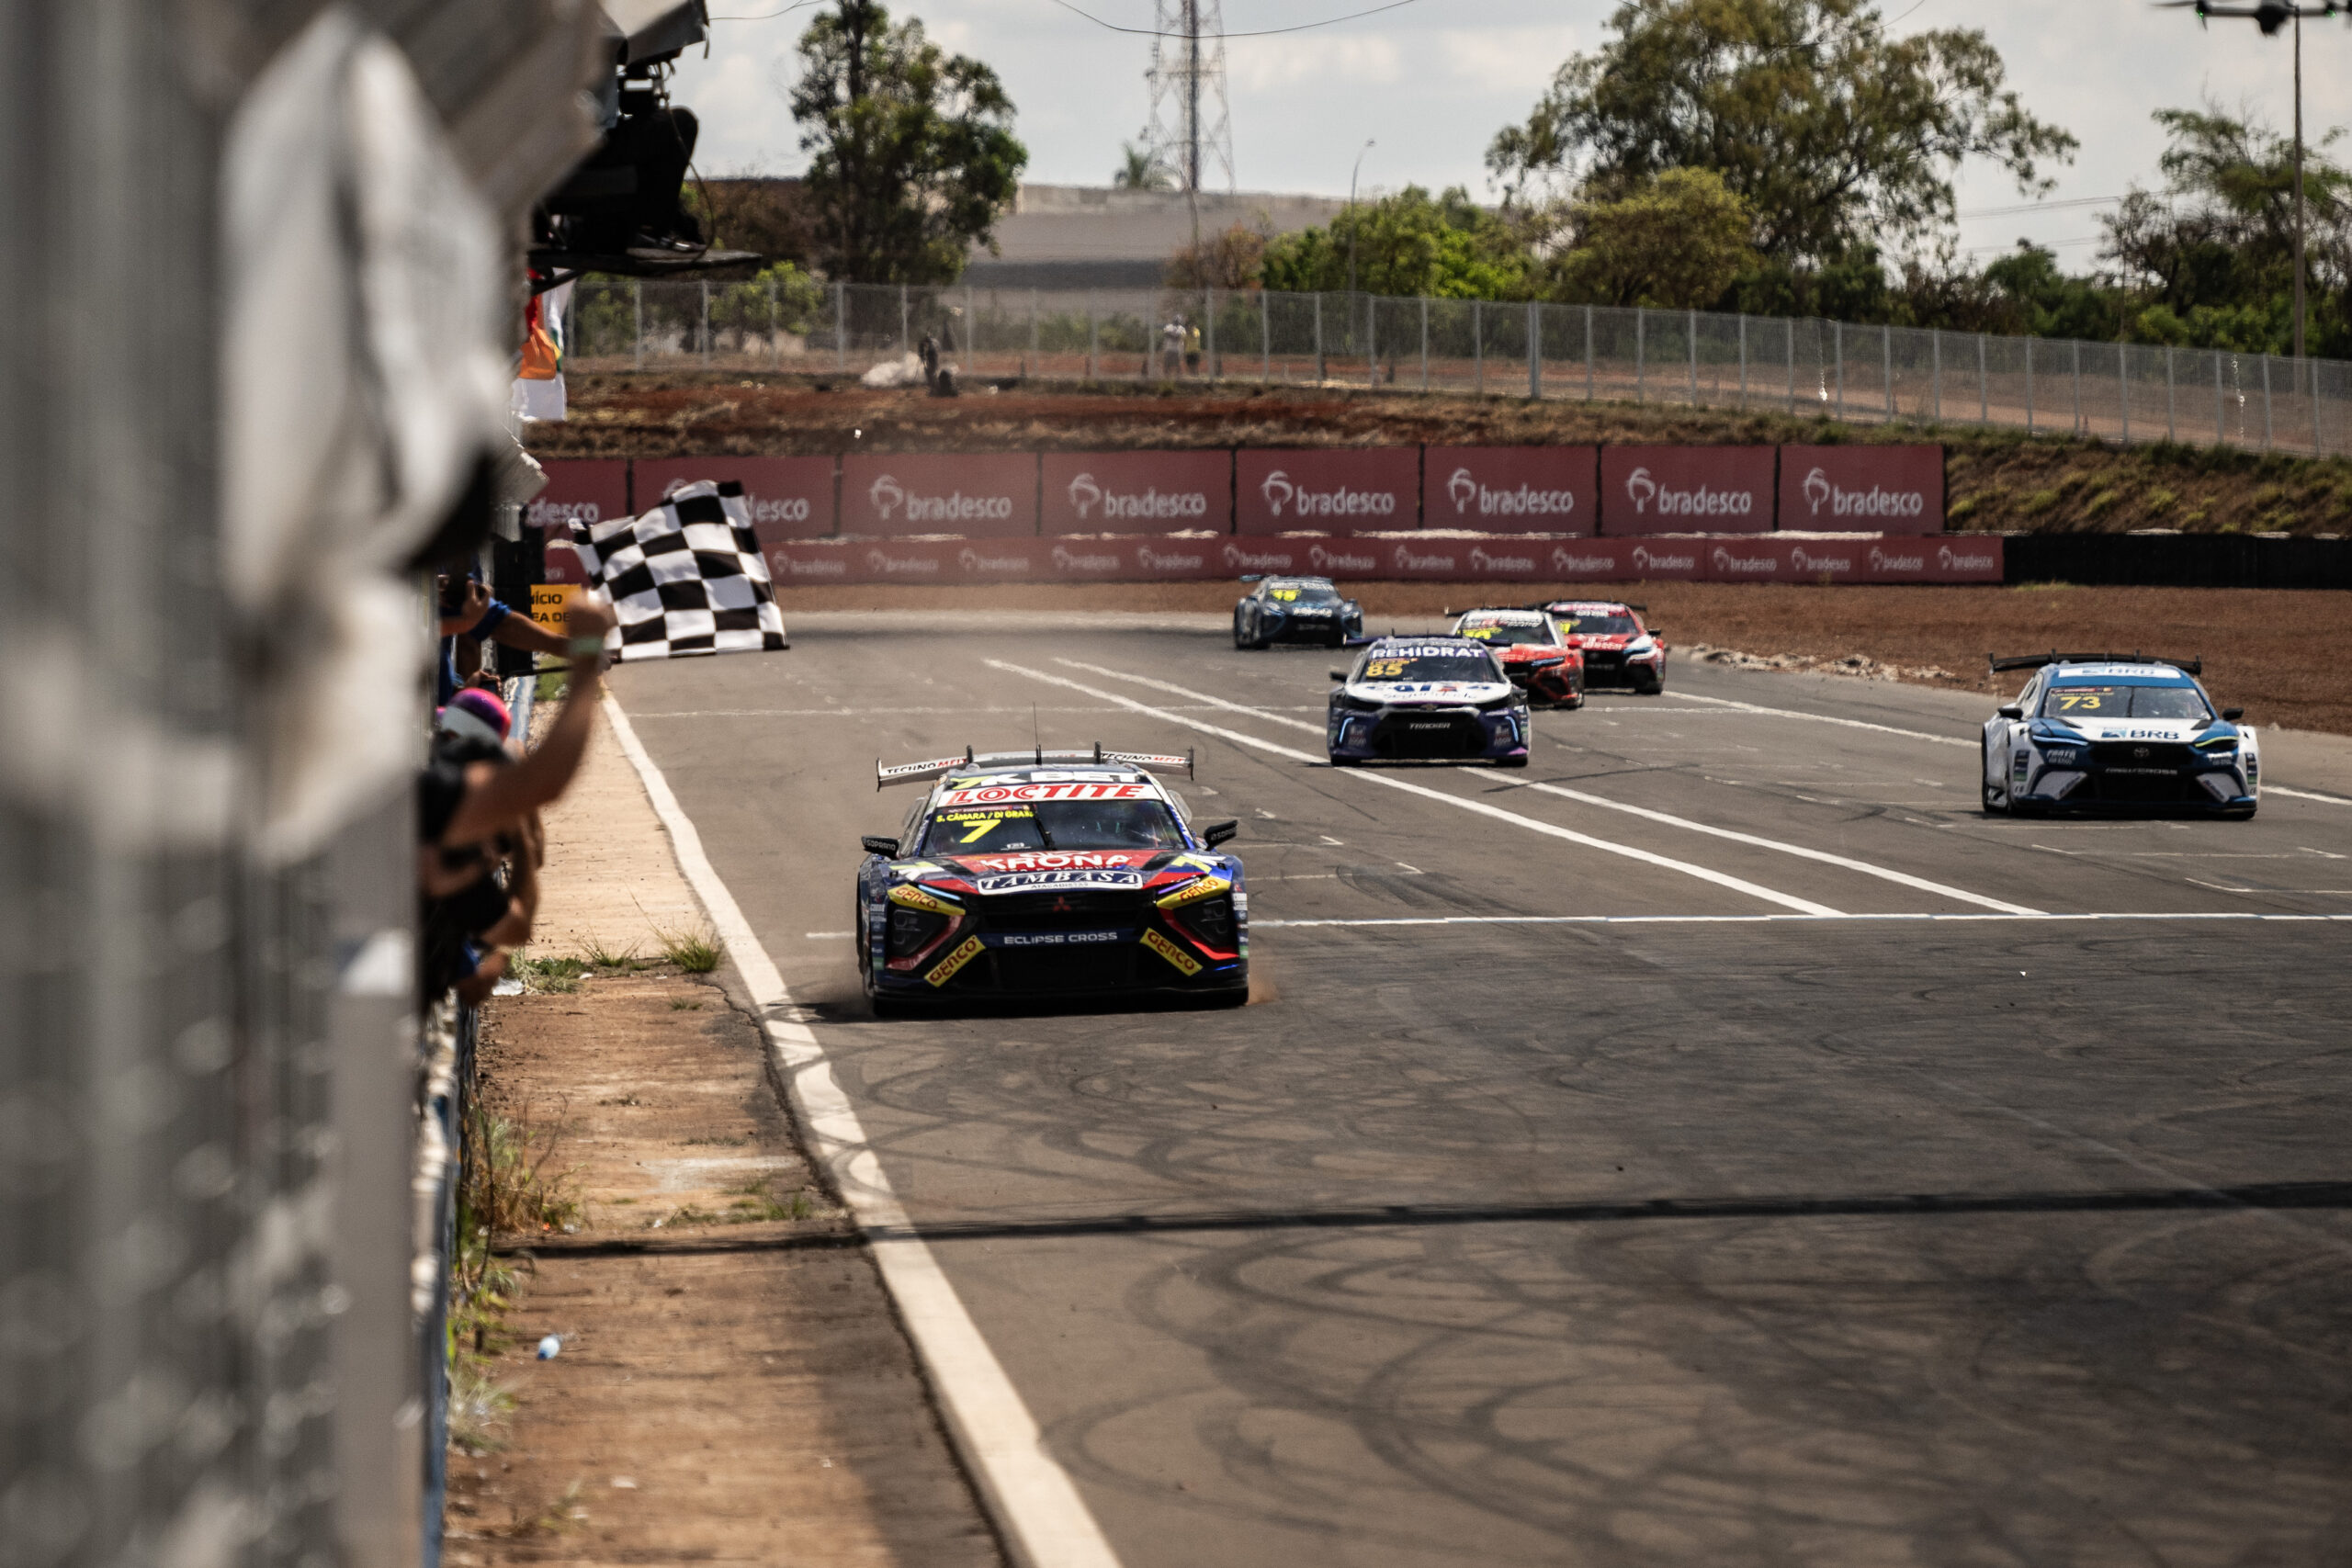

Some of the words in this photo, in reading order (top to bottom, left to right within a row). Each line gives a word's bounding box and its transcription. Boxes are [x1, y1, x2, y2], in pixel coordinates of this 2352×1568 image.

[905, 490, 1011, 522] bradesco
[1105, 489, 1206, 518] bradesco
[1296, 485, 1395, 515] bradesco
[1479, 482, 1575, 514] bradesco
[1658, 483, 1752, 514] bradesco
[1833, 484, 1923, 515] bradesco
[526, 496, 599, 526] desco
[1649, 554, 1694, 570] bradesco
[531, 591, 562, 605] ÍCIO
[533, 612, 549, 623] EA
[1372, 646, 1484, 659] REHIDRAT
[1365, 664, 1403, 677] 85
[2059, 695, 2101, 710] 73
[2130, 729, 2179, 739] BRB
[946, 784, 1145, 806] LOCTITE
[946, 812, 986, 822] CÂMARA
[959, 818, 1001, 843] 7
[979, 854, 1130, 871] KRONA
[982, 872, 1139, 889] TAMBASA
[1179, 878, 1220, 902] GENCO
[895, 886, 938, 909] GENCO
[1004, 933, 1065, 945] ECLIPSE
[1069, 931, 1117, 943] CROSS
[929, 939, 978, 982] GENCO
[1147, 931, 1195, 971] GENCO
